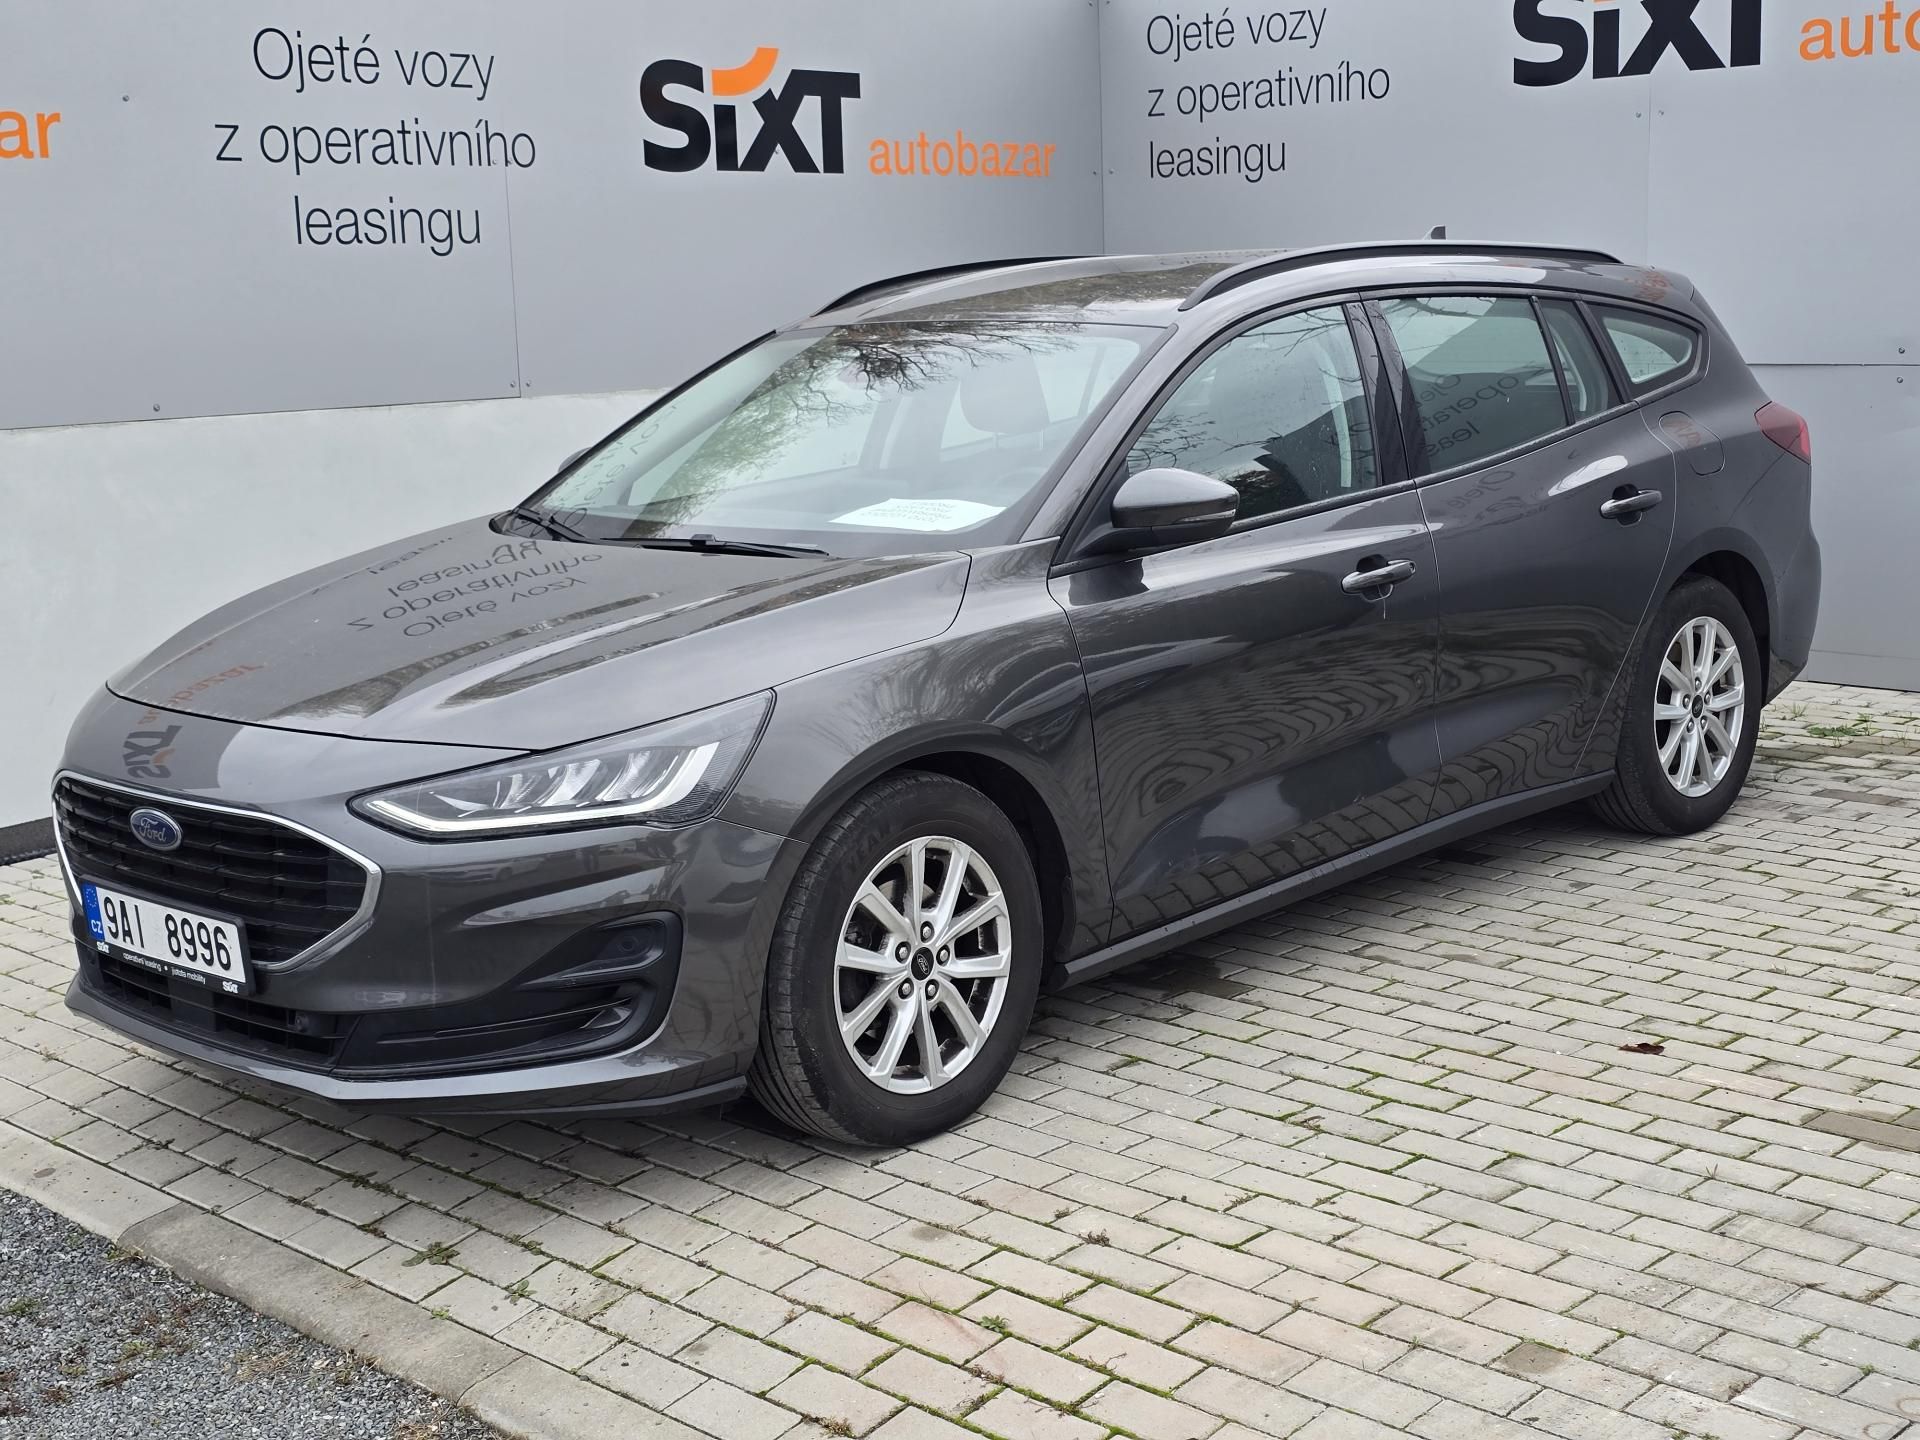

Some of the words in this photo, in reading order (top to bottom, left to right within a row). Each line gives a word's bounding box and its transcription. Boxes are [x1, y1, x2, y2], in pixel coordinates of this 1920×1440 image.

[1147, 6, 1236, 62] Ojeté
[1246, 7, 1328, 51] vozy
[253, 28, 380, 94] Ojeté
[395, 49, 495, 101] vozy
[1148, 88, 1167, 118] z
[1176, 61, 1391, 124] operativního
[215, 124, 243, 162] z
[260, 118, 537, 176] operativního
[867, 129, 1057, 178] autobazar
[1149, 138, 1287, 183] leasingu
[294, 195, 482, 257] leasingu
[139, 817, 168, 842] Ford
[91, 919, 103, 934] CZ
[104, 896, 145, 949] 9AI
[165, 913, 231, 971] 8996
